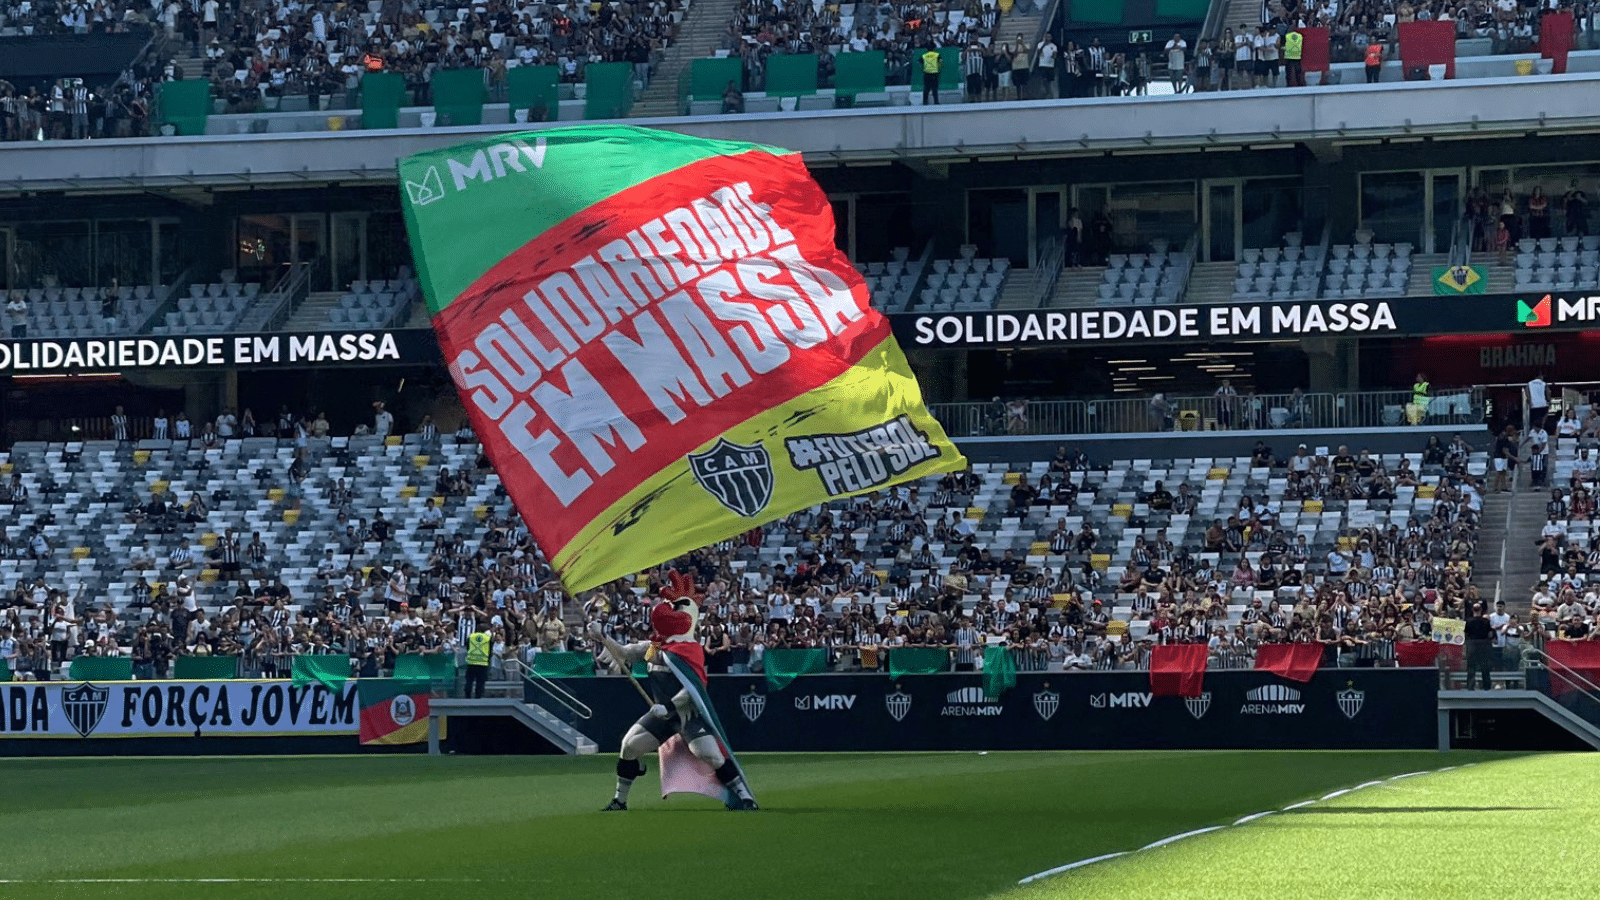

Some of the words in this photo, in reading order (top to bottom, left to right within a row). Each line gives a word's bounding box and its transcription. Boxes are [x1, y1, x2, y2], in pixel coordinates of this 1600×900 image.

[447, 136, 547, 191] MRV
[448, 181, 796, 420] SOLIDARIEDADE
[915, 308, 1198, 344] SOLIDARIEDADE
[1210, 306, 1261, 335] EM
[1272, 302, 1396, 333] MASSA
[234, 336, 281, 363] EM
[289, 333, 400, 362] MASSA
[1480, 344, 1556, 367] BRAHMA
[499, 357, 648, 508] EM
[600, 244, 866, 425] MASSA
[788, 417, 926, 466] #FUTEBOL
[703, 453, 759, 473] CAM
[820, 451, 888, 494] PELO
[885, 441, 938, 471] SUL
[68, 692, 102, 701] CAM
[121, 684, 232, 737] FORÇA
[241, 684, 358, 726] JOVEM
[814, 695, 857, 710] MRV
[941, 706, 1003, 716] ARENAMRV
[1109, 692, 1154, 708] MRV
[1240, 704, 1306, 714] ARENAMRV
